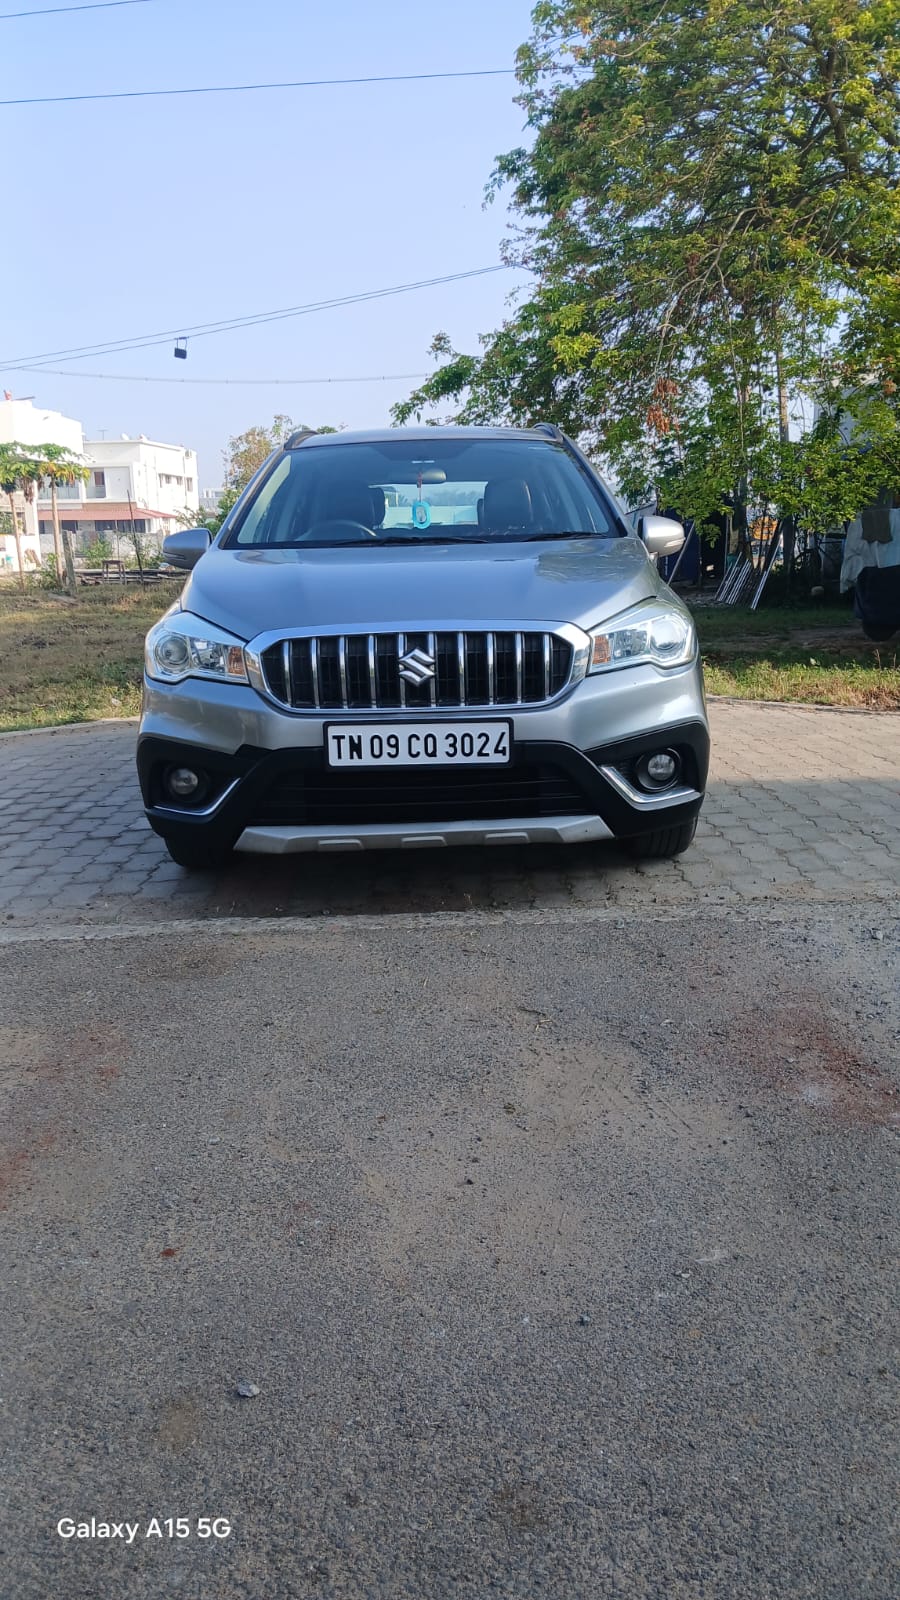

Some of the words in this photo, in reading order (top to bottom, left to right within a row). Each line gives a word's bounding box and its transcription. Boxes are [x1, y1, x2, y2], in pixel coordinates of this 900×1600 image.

[331, 734, 363, 760] TN
[369, 734, 400, 759] 09
[407, 732, 438, 758] CQ
[444, 731, 507, 758] 3024
